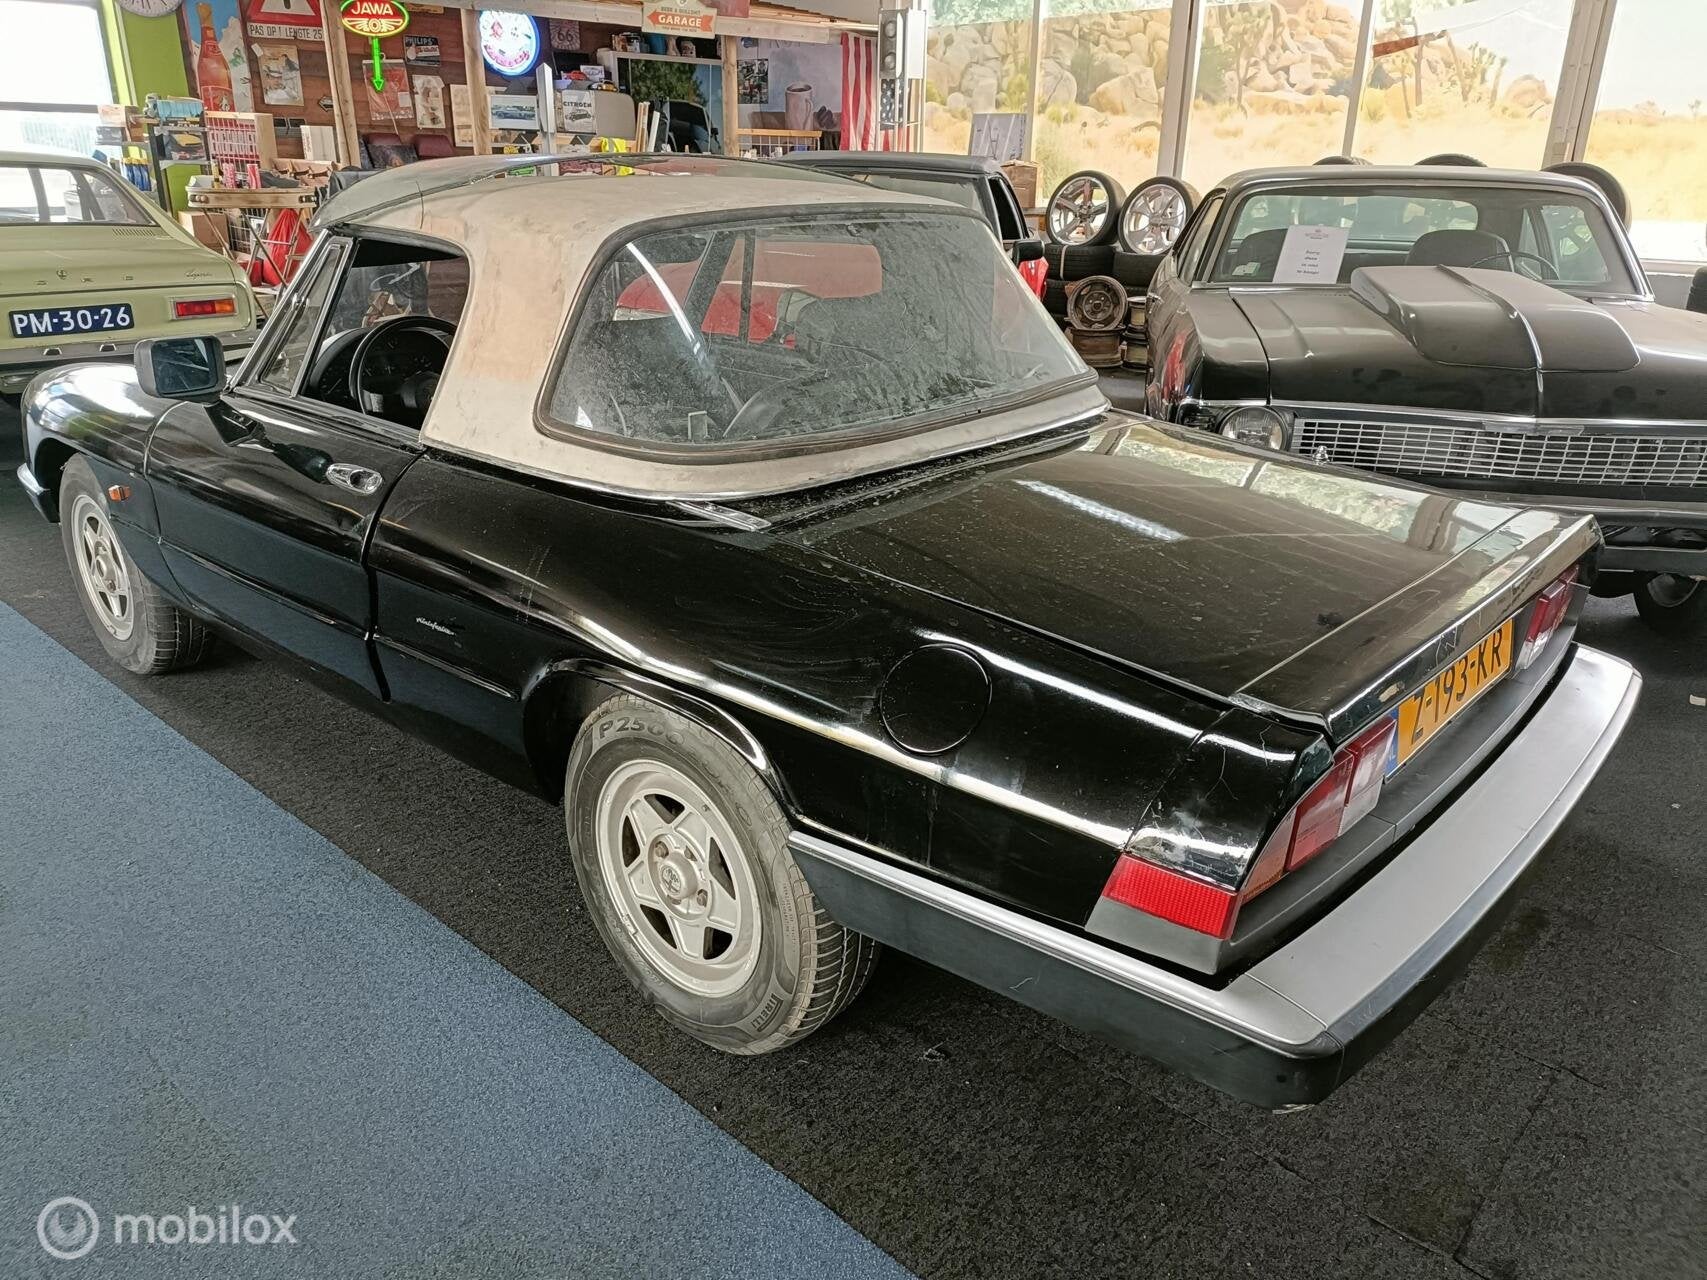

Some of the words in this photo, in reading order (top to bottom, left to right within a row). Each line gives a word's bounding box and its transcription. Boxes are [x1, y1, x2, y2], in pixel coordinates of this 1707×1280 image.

[351, 1, 394, 16] JAWA
[249, 24, 264, 36] PAS
[266, 25, 277, 37] OP
[658, 14, 702, 27] GARAGE
[12, 306, 131, 335] PM-30-26
[1410, 627, 1503, 745] Z-193-KR
[750, 992, 784, 1033] PIRELLI
